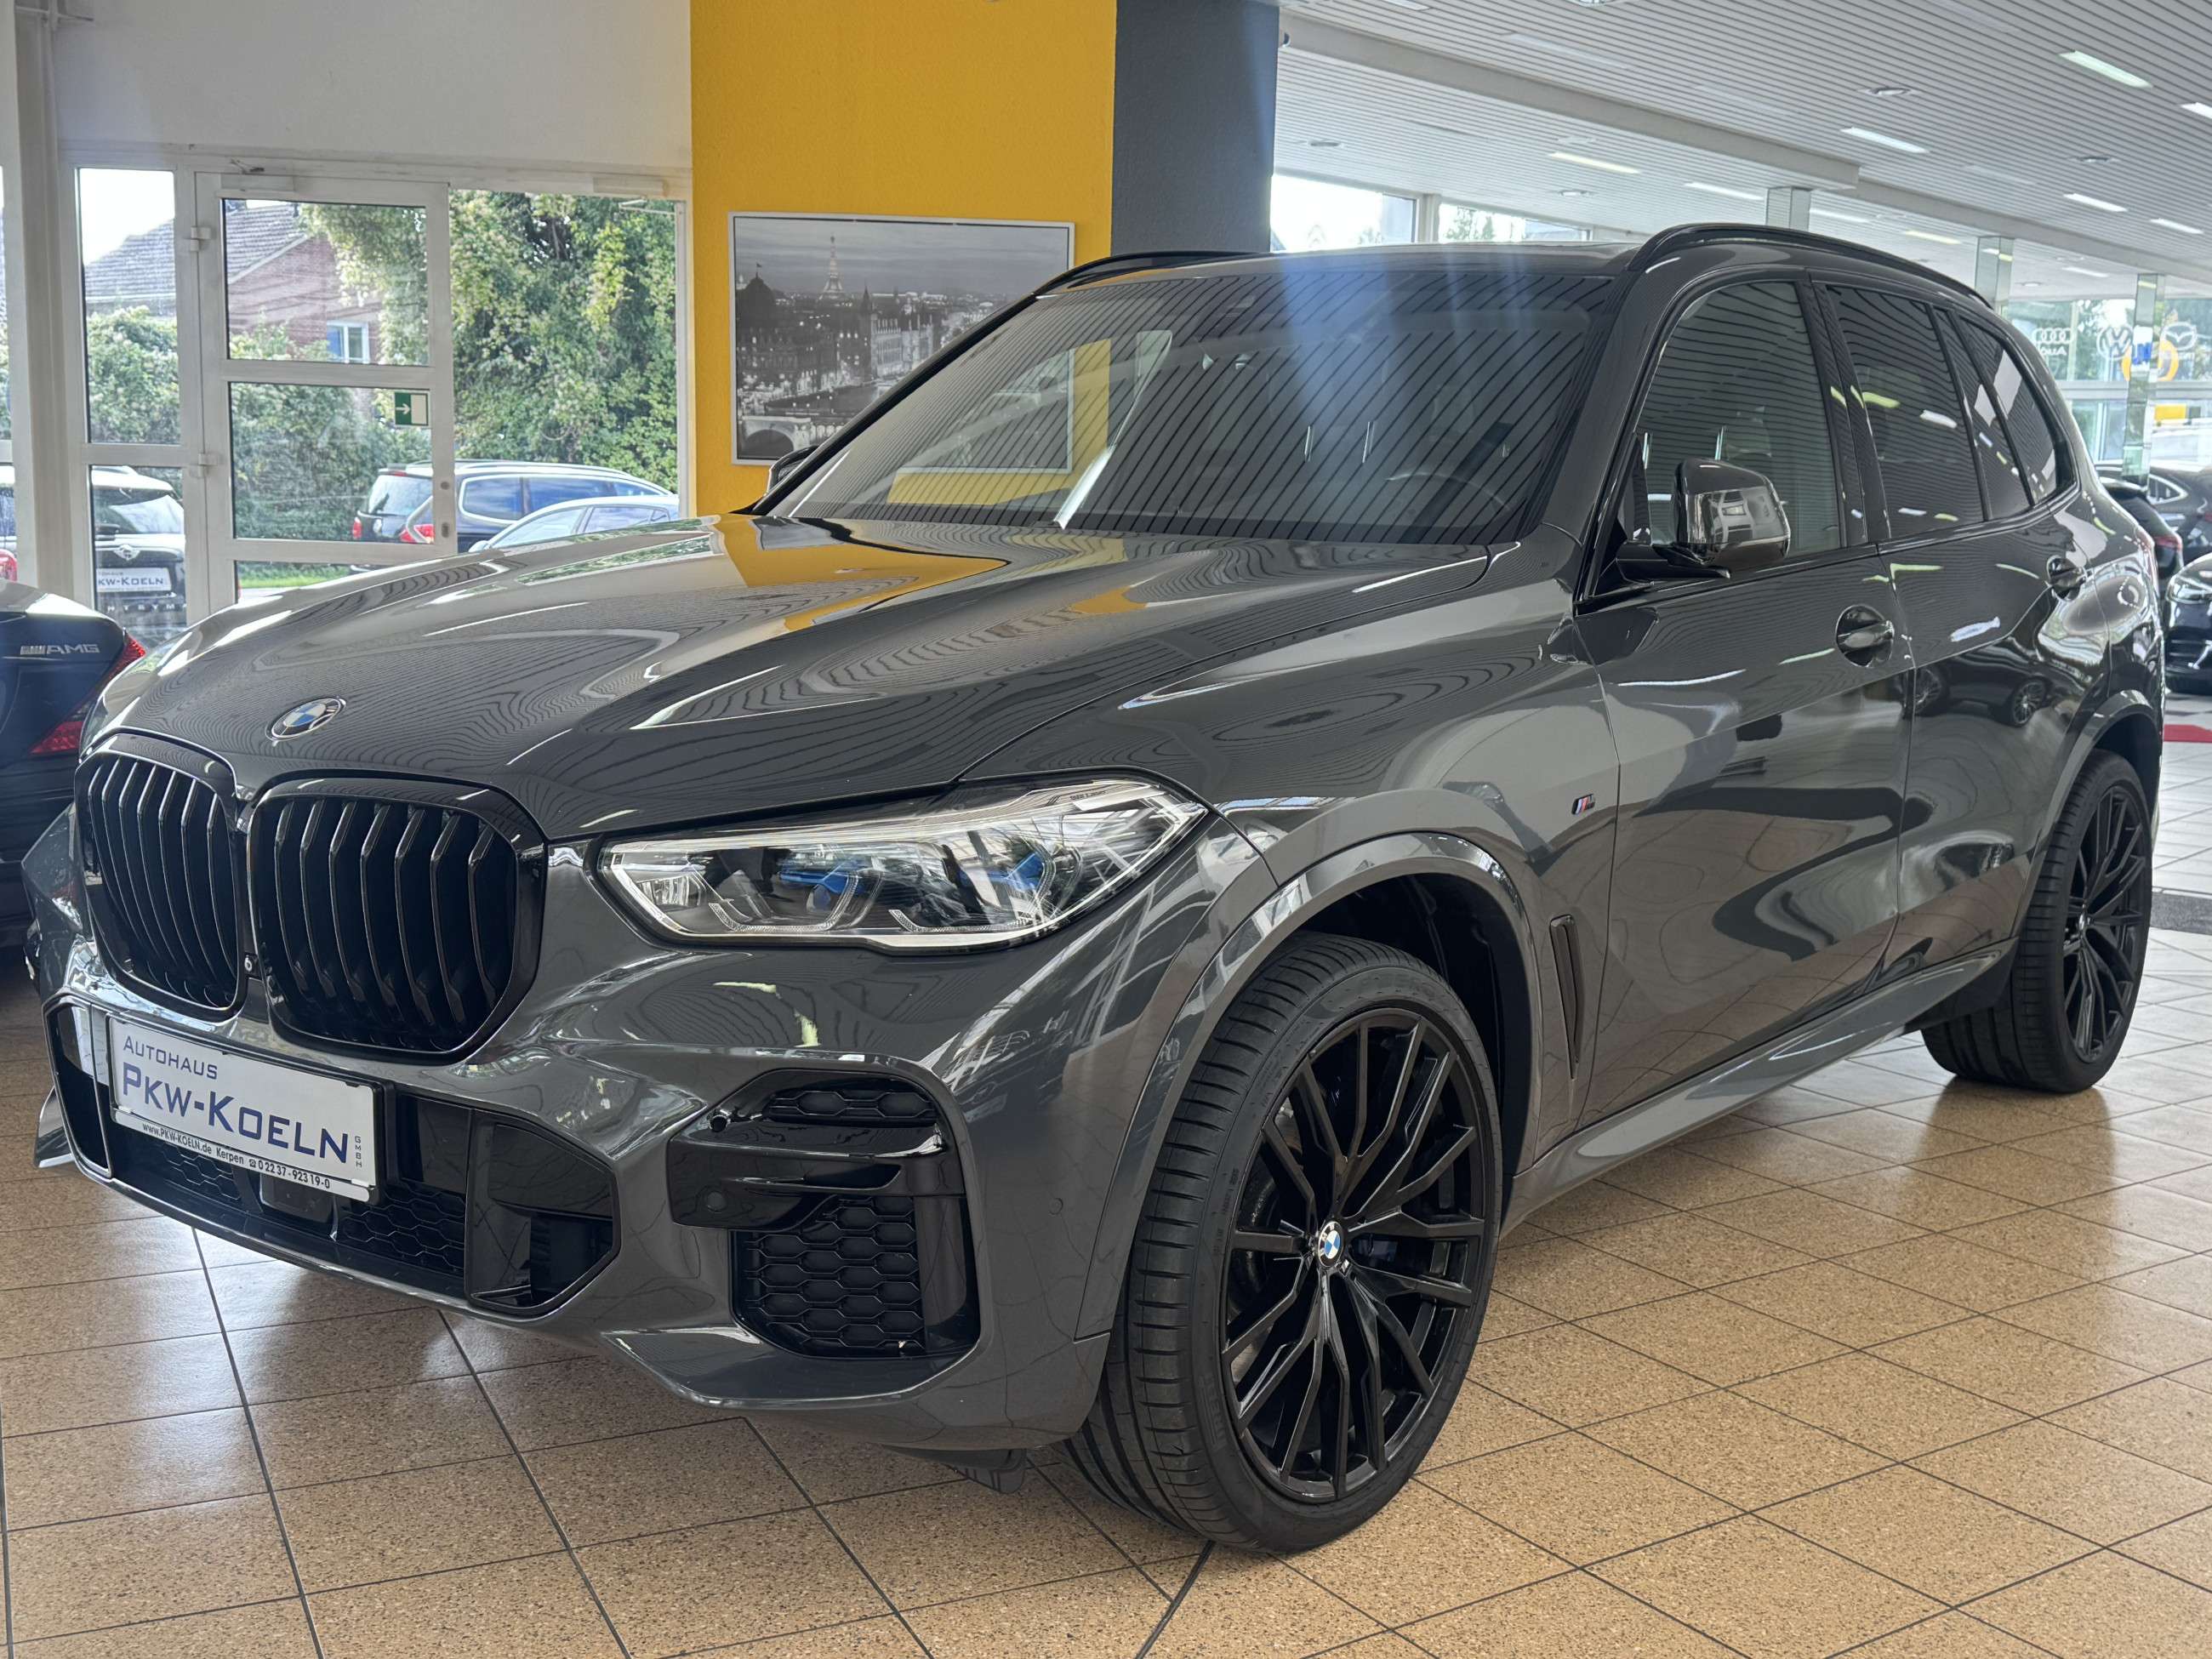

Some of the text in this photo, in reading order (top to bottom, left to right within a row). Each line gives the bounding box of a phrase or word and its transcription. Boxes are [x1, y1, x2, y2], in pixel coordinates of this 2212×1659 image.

[98, 576, 164, 586] KW-KOELN
[46, 643, 100, 655] AMG
[123, 1035, 218, 1080] AUTOHAUS
[123, 1062, 349, 1164] PKW-KOELN
[142, 1123, 212, 1154] www.PKW-KOELN.de
[216, 1147, 244, 1165] Kerpen
